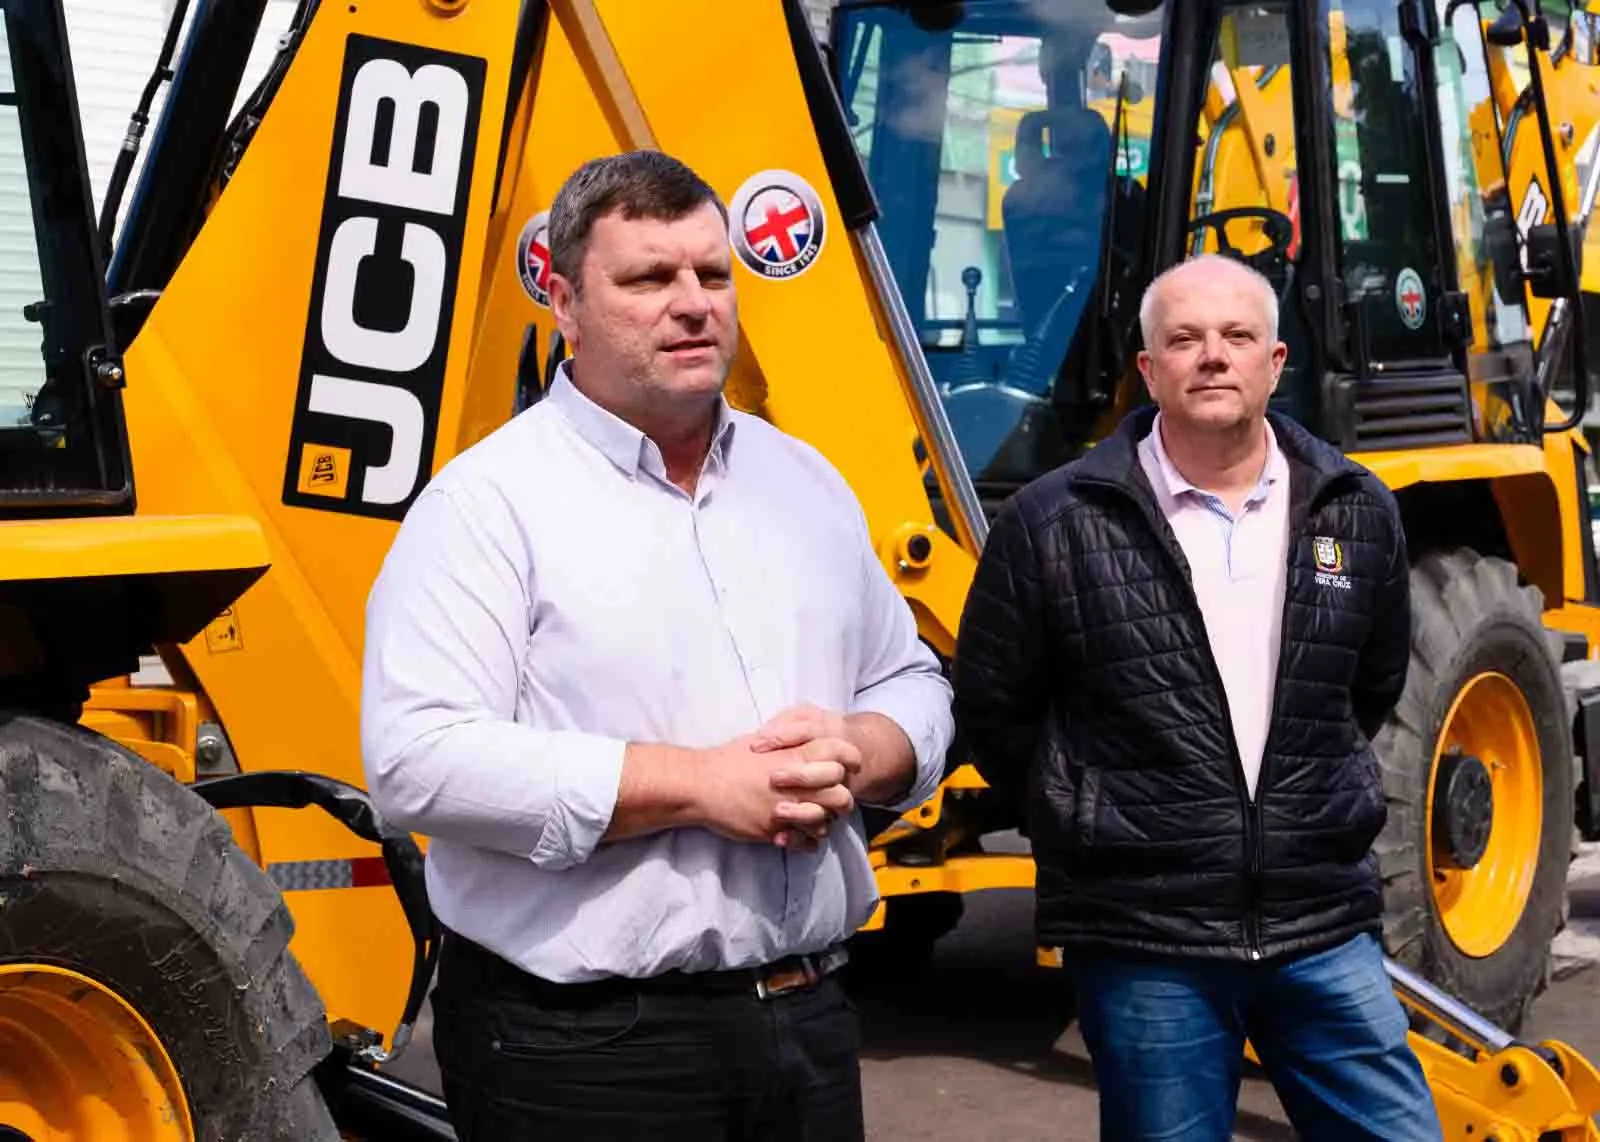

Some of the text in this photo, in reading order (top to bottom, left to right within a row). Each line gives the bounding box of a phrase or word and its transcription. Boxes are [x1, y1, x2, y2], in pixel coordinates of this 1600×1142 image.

[765, 243, 818, 276] SINCE 1945
[309, 59, 469, 504] JCB
[312, 455, 334, 481] JCB
[1315, 576, 1331, 585] VERA
[1332, 580, 1351, 589] CRUZ
